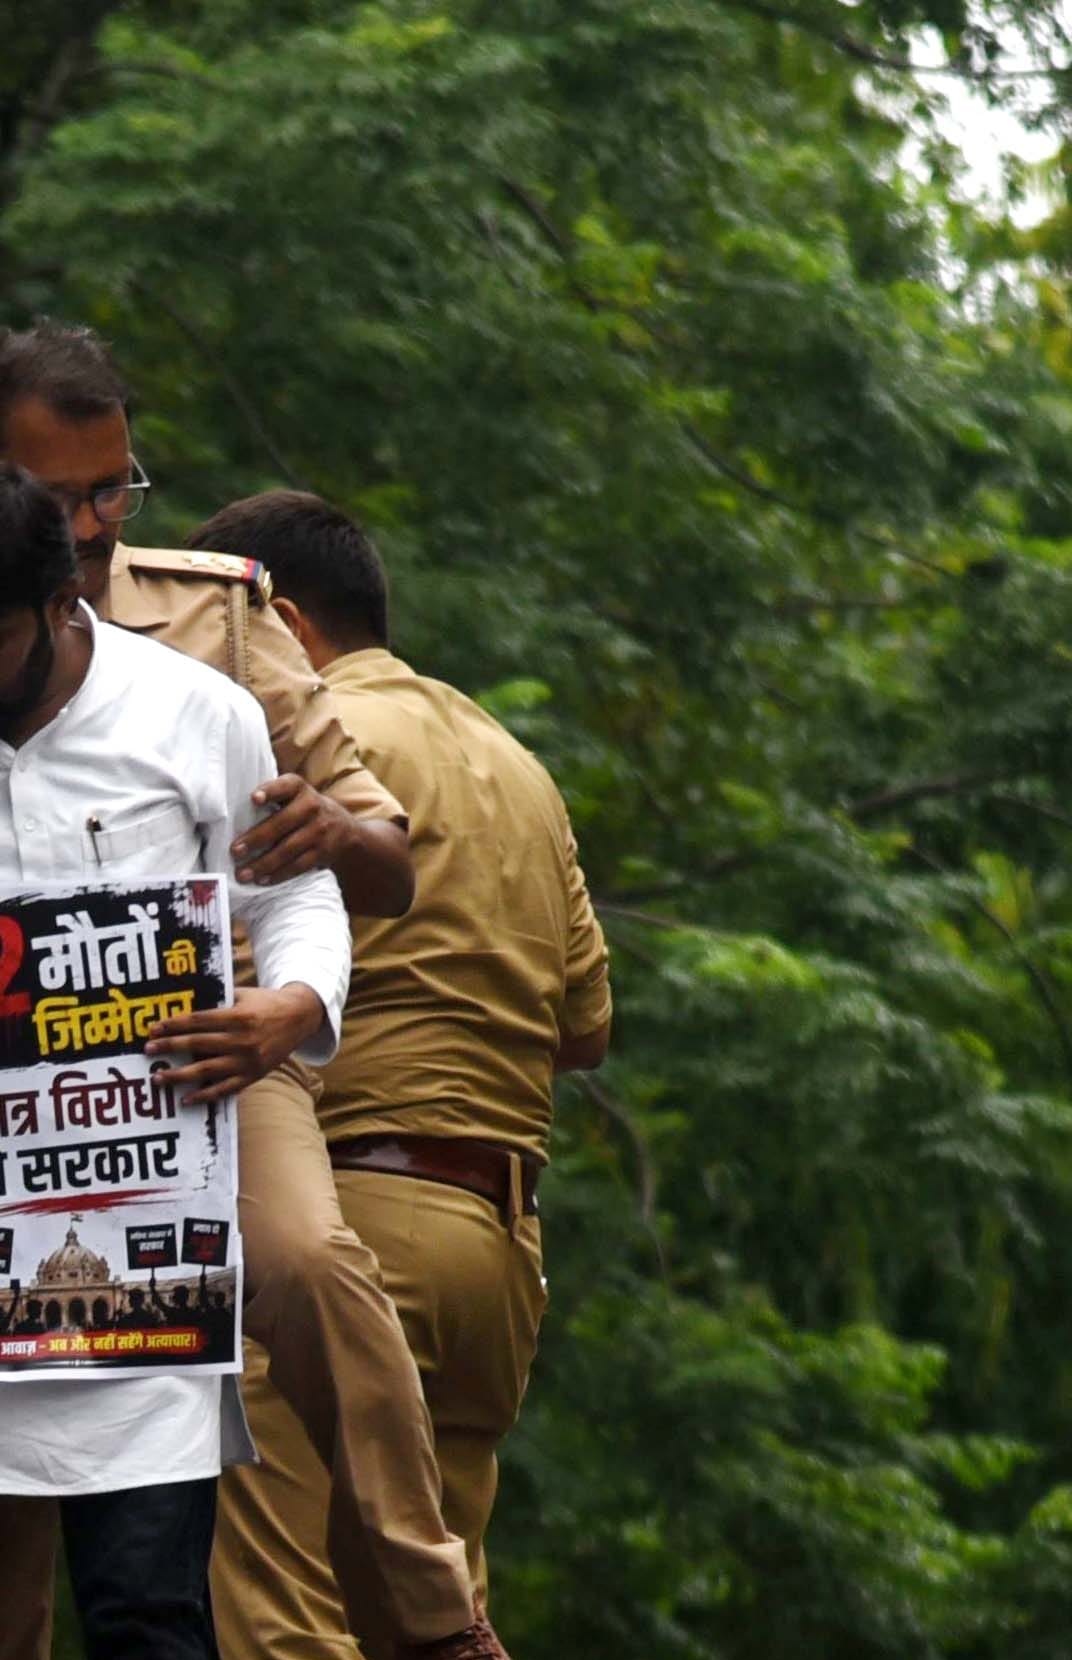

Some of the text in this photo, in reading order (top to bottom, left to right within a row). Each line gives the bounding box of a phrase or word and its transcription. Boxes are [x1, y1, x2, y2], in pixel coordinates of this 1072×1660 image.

[32, 904, 160, 991] मौतों
[163, 939, 196, 976] की
[17, 1132, 180, 1193] सरकार
